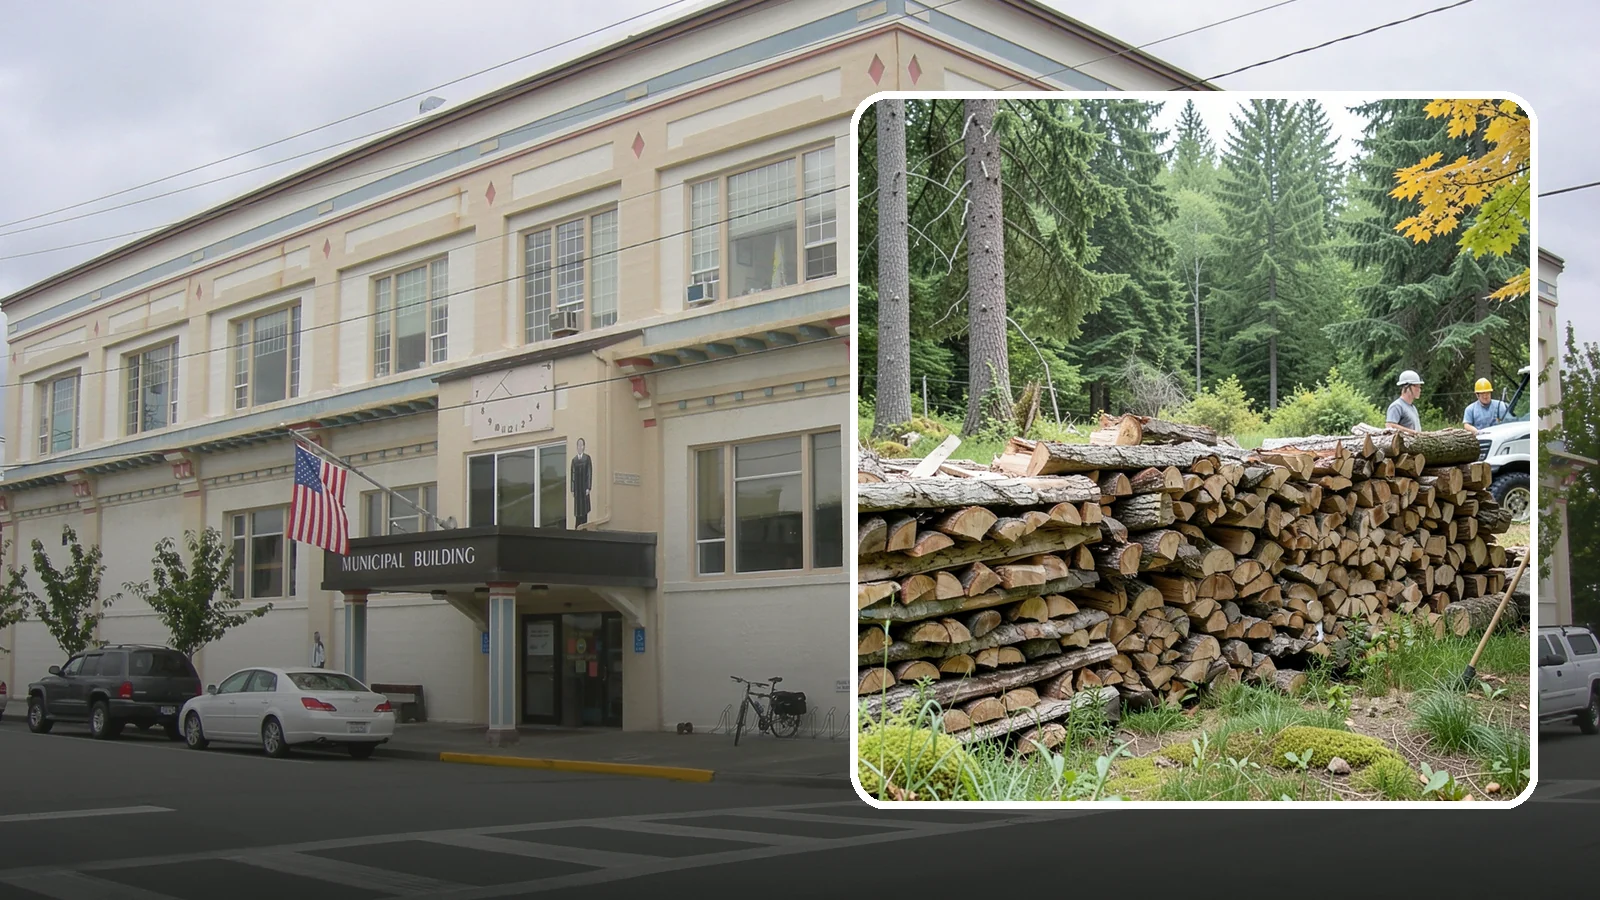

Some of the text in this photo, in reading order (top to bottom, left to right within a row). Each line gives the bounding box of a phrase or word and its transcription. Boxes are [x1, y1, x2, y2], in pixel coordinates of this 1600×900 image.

[475, 389, 479, 398] 7
[480, 406, 485, 415] 8
[487, 417, 492, 426] 9
[494, 423, 500, 432] 10
[501, 425, 506, 433] 11
[507, 425, 514, 433] 12
[521, 420, 526, 429] 2
[528, 413, 533, 422] 3
[536, 402, 540, 410] 4
[546, 362, 551, 370] 6
[342, 546, 475, 572] MUNICIPAL BUILDING
